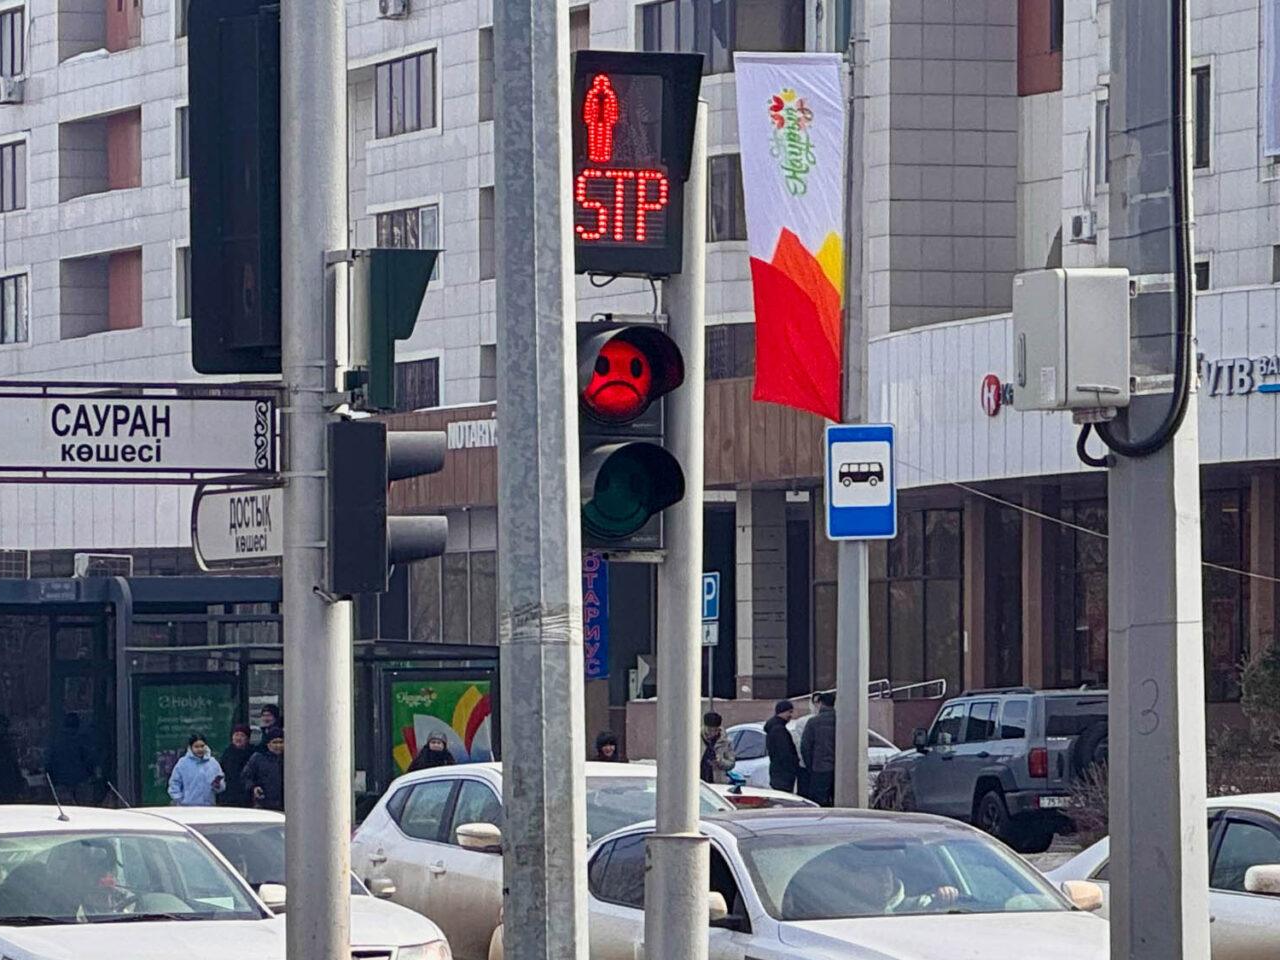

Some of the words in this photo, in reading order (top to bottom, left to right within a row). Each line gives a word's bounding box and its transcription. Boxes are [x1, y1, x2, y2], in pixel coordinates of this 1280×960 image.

[575, 168, 668, 241] STP
[1200, 358, 1254, 396] VTB
[1259, 355, 1280, 376] BA
[51, 403, 171, 437] САУРАН
[61, 439, 161, 462] көшесі
[229, 494, 272, 536] ДОСТЫҚ
[235, 528, 268, 553] көшесі
[583, 550, 601, 675] ОТАРИУС
[703, 576, 716, 617] P
